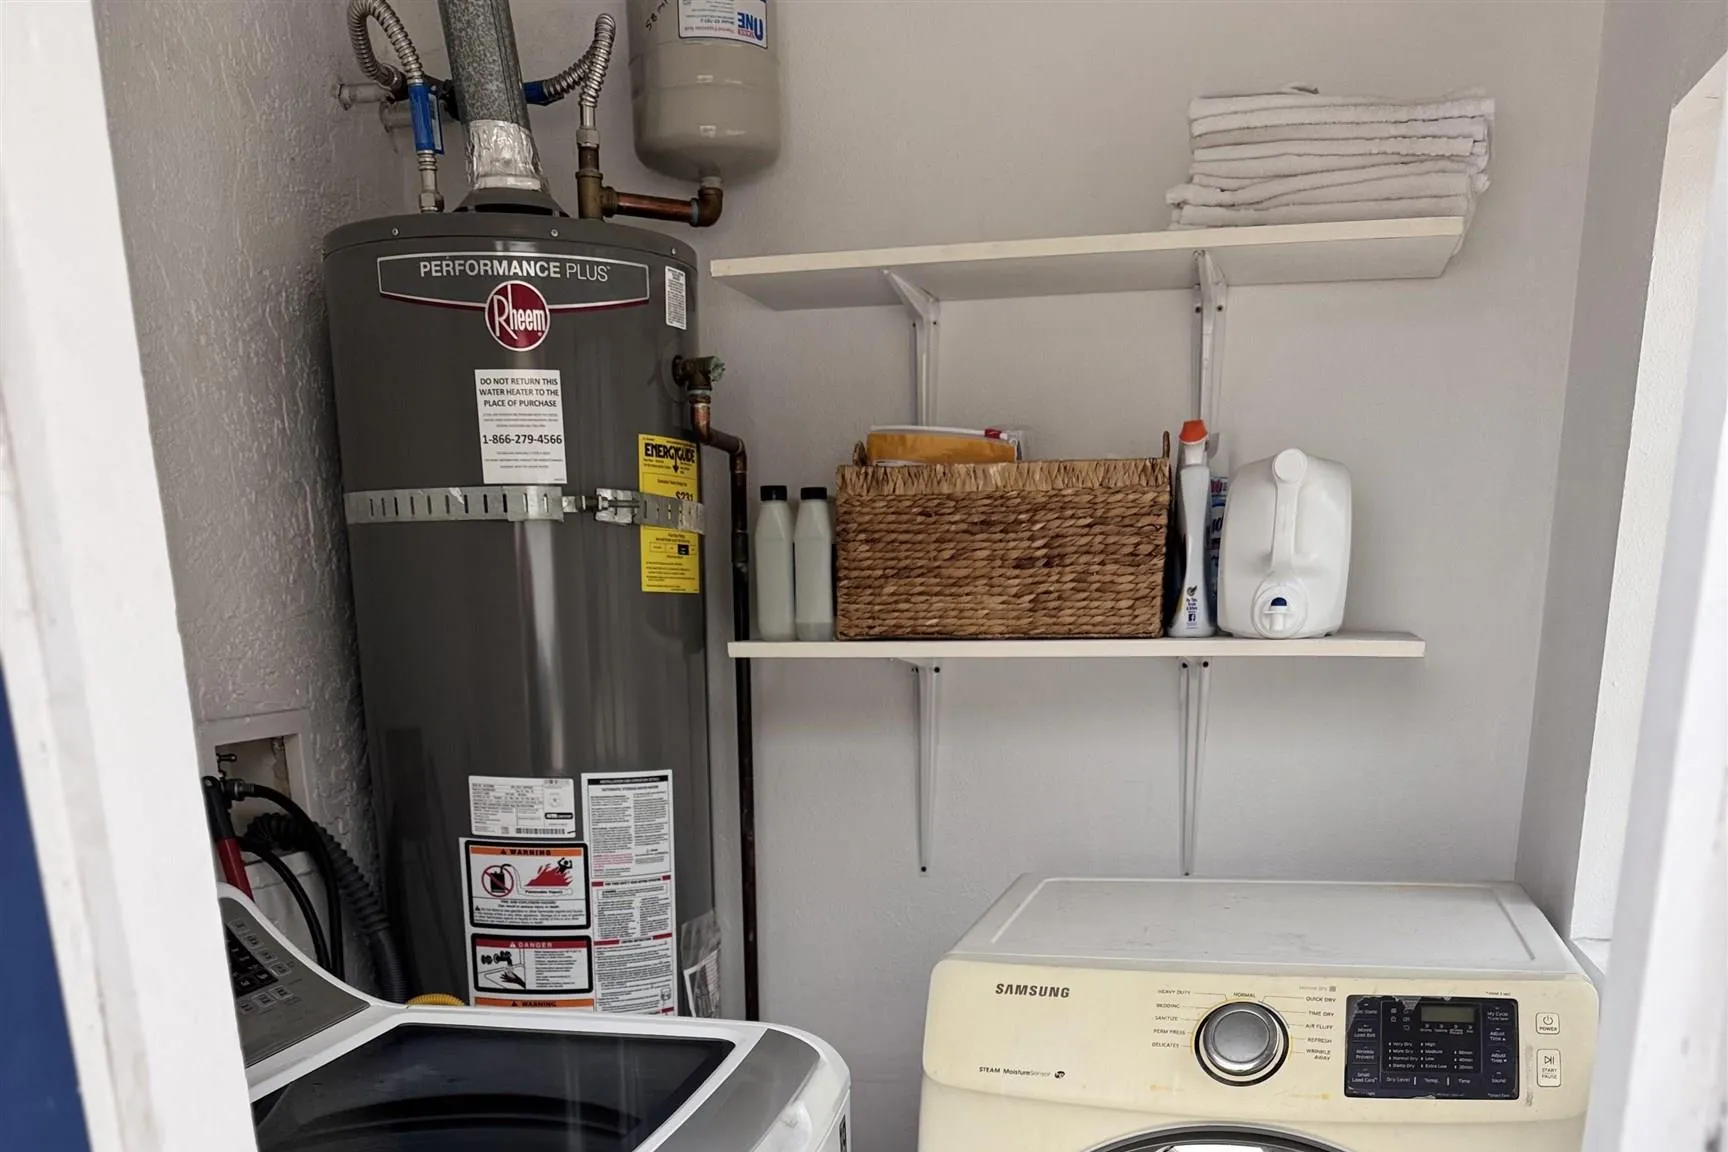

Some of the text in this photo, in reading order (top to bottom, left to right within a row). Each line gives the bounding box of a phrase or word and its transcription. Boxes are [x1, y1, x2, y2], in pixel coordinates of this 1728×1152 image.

[420, 260, 561, 279] PERFORMANCE
[493, 284, 547, 340] Rheem
[493, 378, 509, 386] NOT
[511, 378, 541, 386] RETURN
[542, 378, 558, 386] THIS
[546, 389, 560, 397] THE
[519, 400, 557, 408] PURCHASE
[482, 434, 563, 445] 1-866-279-4566
[510, 848, 552, 856] WARNING
[995, 983, 1071, 999] SAMSUNG
